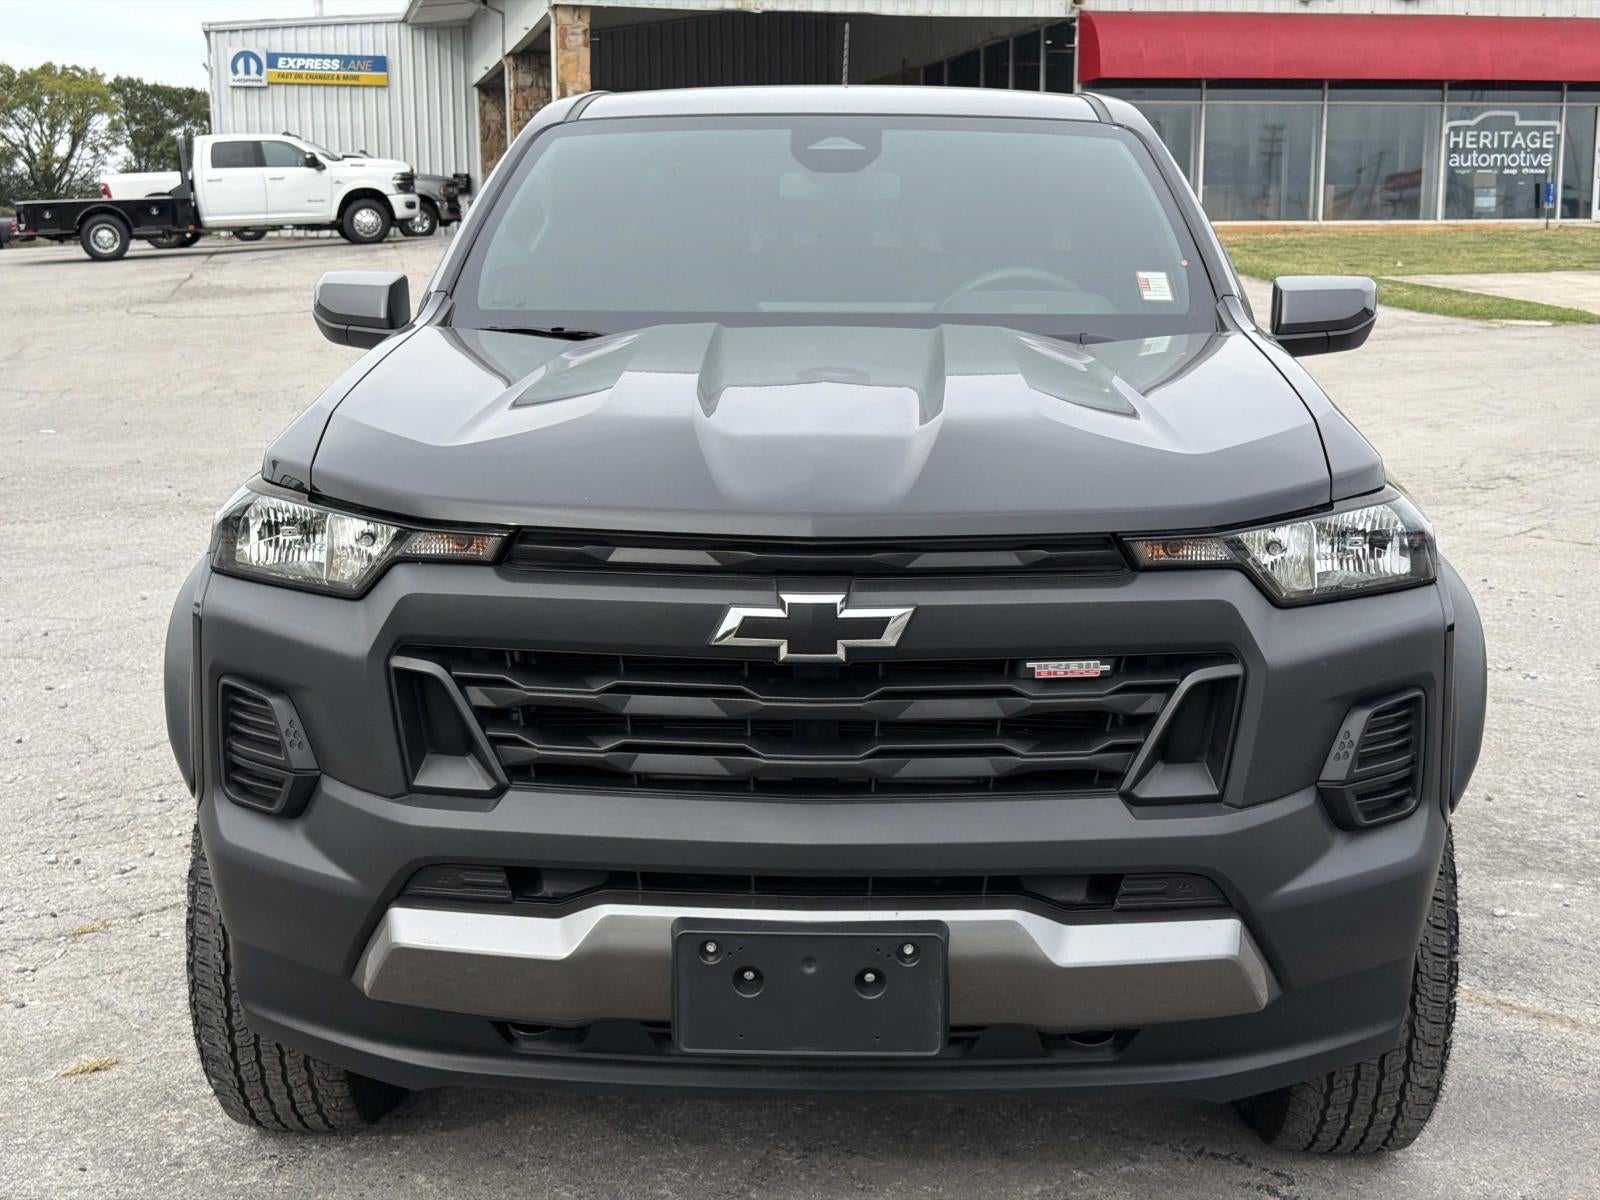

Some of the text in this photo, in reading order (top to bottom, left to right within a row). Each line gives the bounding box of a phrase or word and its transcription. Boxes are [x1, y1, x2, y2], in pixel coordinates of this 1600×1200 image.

[277, 72, 293, 80] FAST
[305, 73, 335, 81] CHANGES
[1449, 131, 1554, 149] HERITAGE
[1449, 149, 1552, 167] automotive
